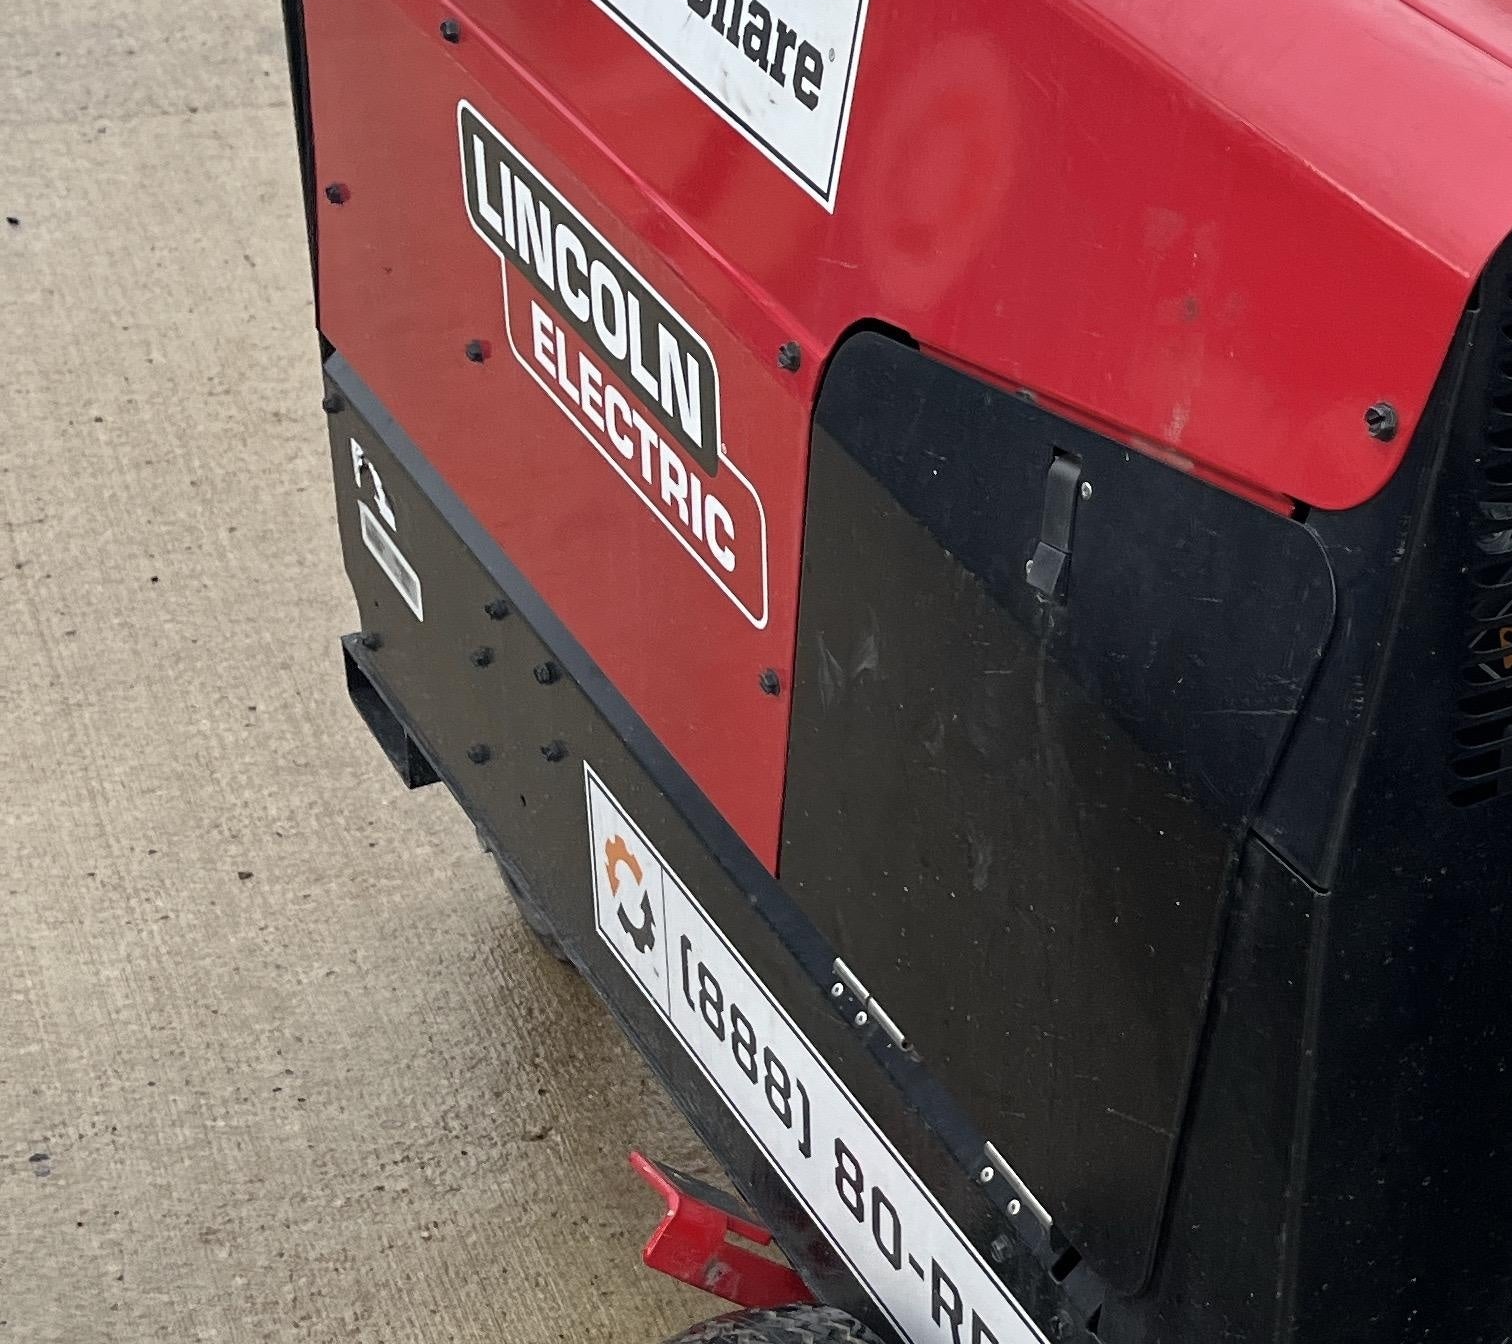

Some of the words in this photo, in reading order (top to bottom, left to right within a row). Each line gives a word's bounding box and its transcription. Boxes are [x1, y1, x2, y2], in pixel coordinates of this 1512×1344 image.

[472, 133, 703, 450] LINCOLN
[530, 299, 736, 573] ELECTRIC
[679, 932, 812, 1161] (888)
